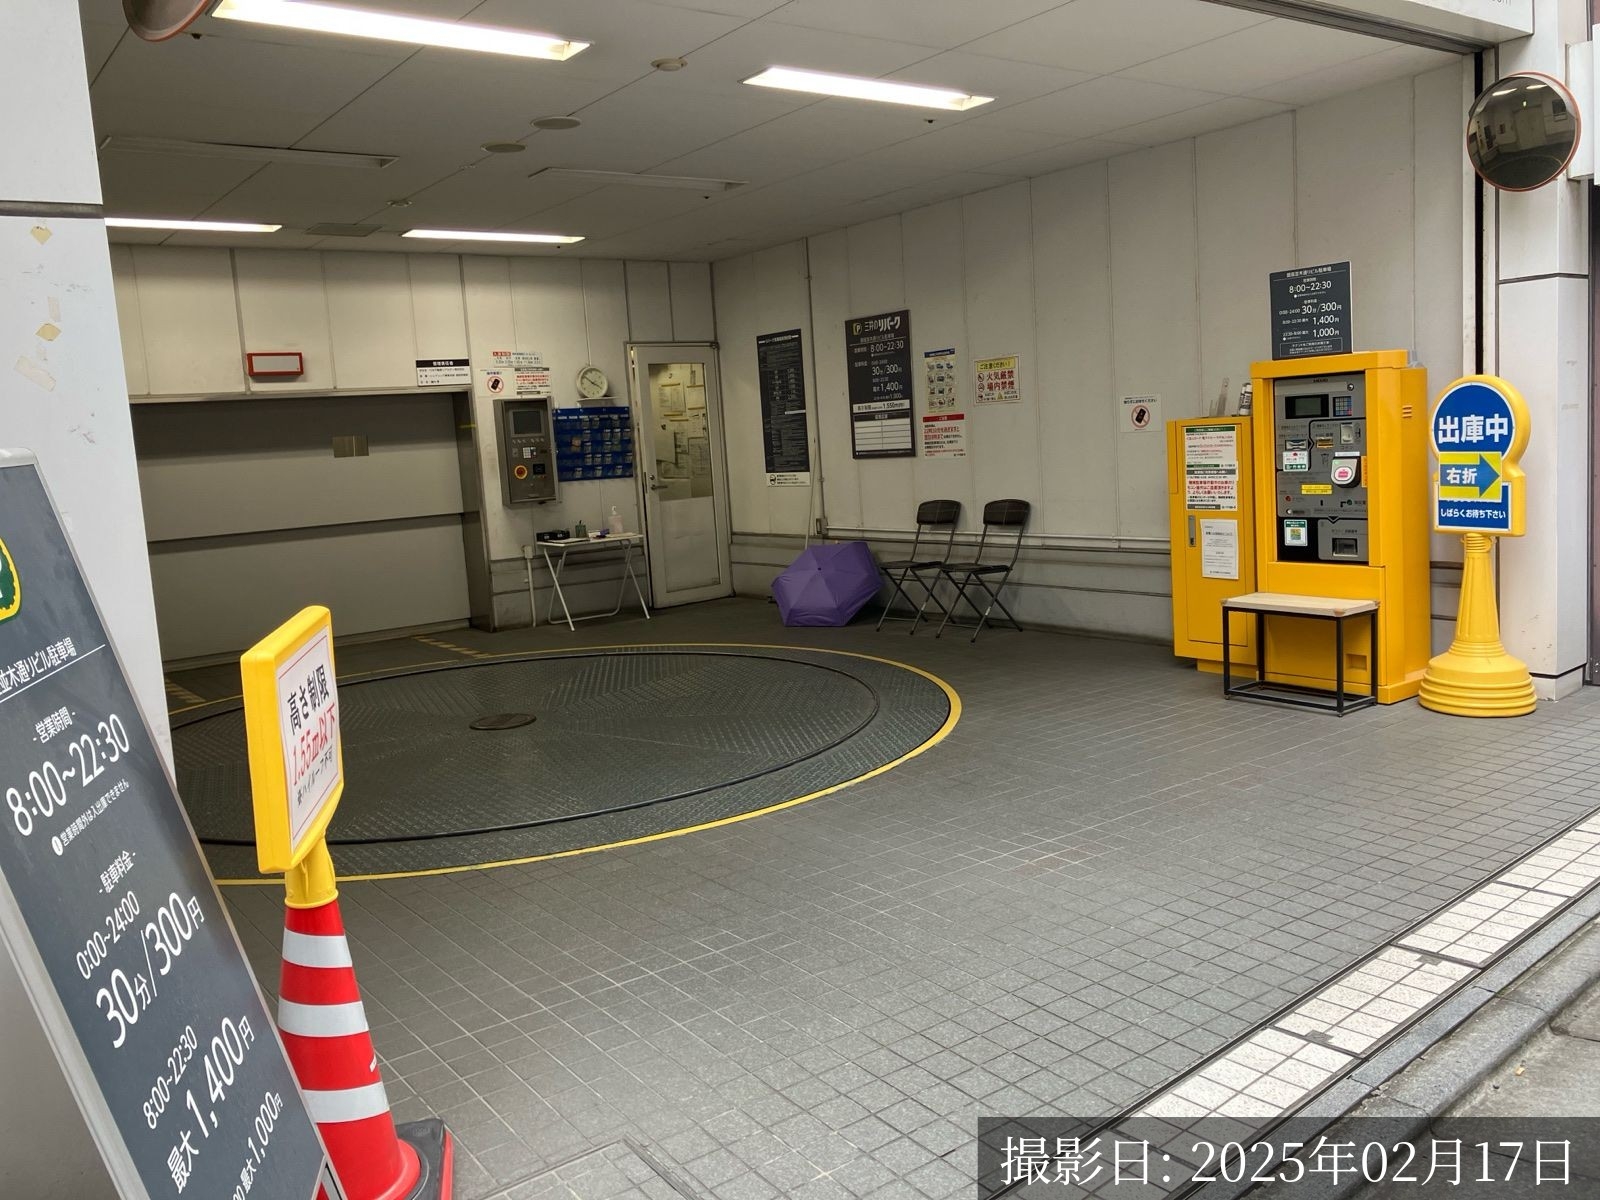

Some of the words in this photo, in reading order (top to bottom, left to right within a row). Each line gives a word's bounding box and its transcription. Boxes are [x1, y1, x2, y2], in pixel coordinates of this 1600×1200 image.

[864, 316, 901, 332] 三井のリパーク
[986, 370, 1015, 381] 火気厳禁
[1438, 414, 1509, 444] 出庫中
[1446, 467, 1478, 485] 右折
[1440, 508, 1506, 519] しばらくお待ち下さい
[0, 637, 77, 696] 並木通りビル駐車場
[287, 664, 330, 735] 高さ制限
[6, 713, 130, 837] 8:00~22:30
[76, 890, 140, 981] 0:00~24:00
[96, 892, 205, 1050] 30分/300円
[143, 1025, 199, 1130] 8:00~22:30
